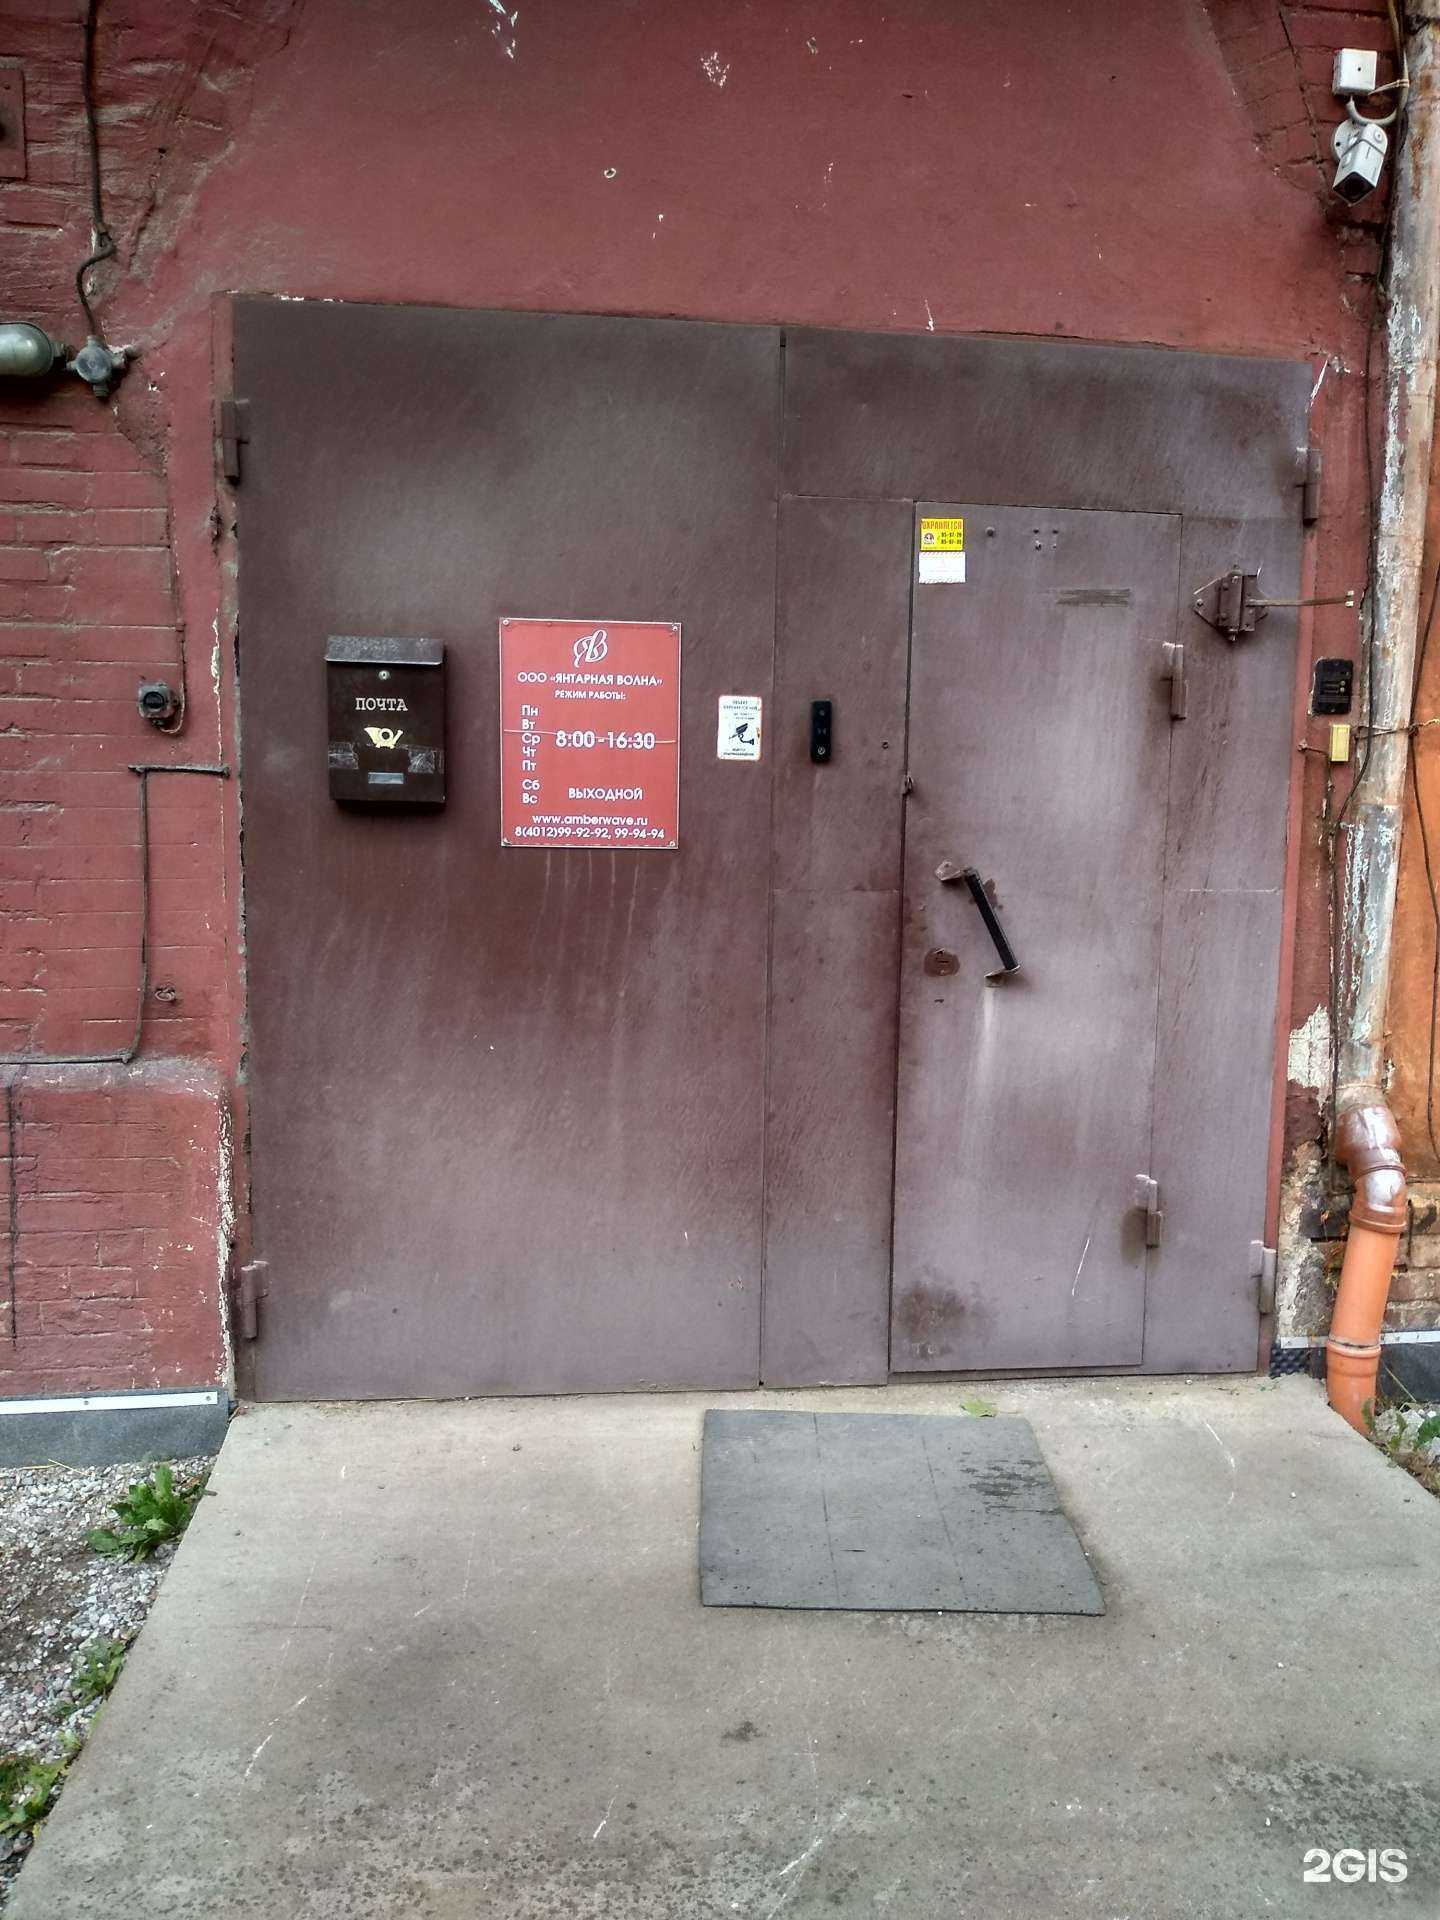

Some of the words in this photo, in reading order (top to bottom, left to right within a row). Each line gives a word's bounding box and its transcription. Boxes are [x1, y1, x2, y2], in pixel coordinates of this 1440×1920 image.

[517, 672, 547, 683] ООО
[550, 673, 614, 685] «ЯНТАРНАЯ
[616, 675, 663, 687] ВОЛНА»
[555, 690, 587, 699] РЕЖИМ
[589, 691, 626, 700] РАБОТЫ:
[355, 697, 408, 711] ПОЧТА
[521, 704, 539, 716] Пн
[521, 719, 536, 730] Вт
[521, 733, 541, 745] Ср
[522, 747, 537, 758] Чт
[522, 760, 537, 771] Пт
[521, 778, 540, 791] Сб
[522, 793, 538, 804] Вс
[568, 787, 643, 801] ВЫХОДНОЙ
[532, 814, 648, 826] www.amberwave.ru
[614, 829, 665, 838] 99-94-94
